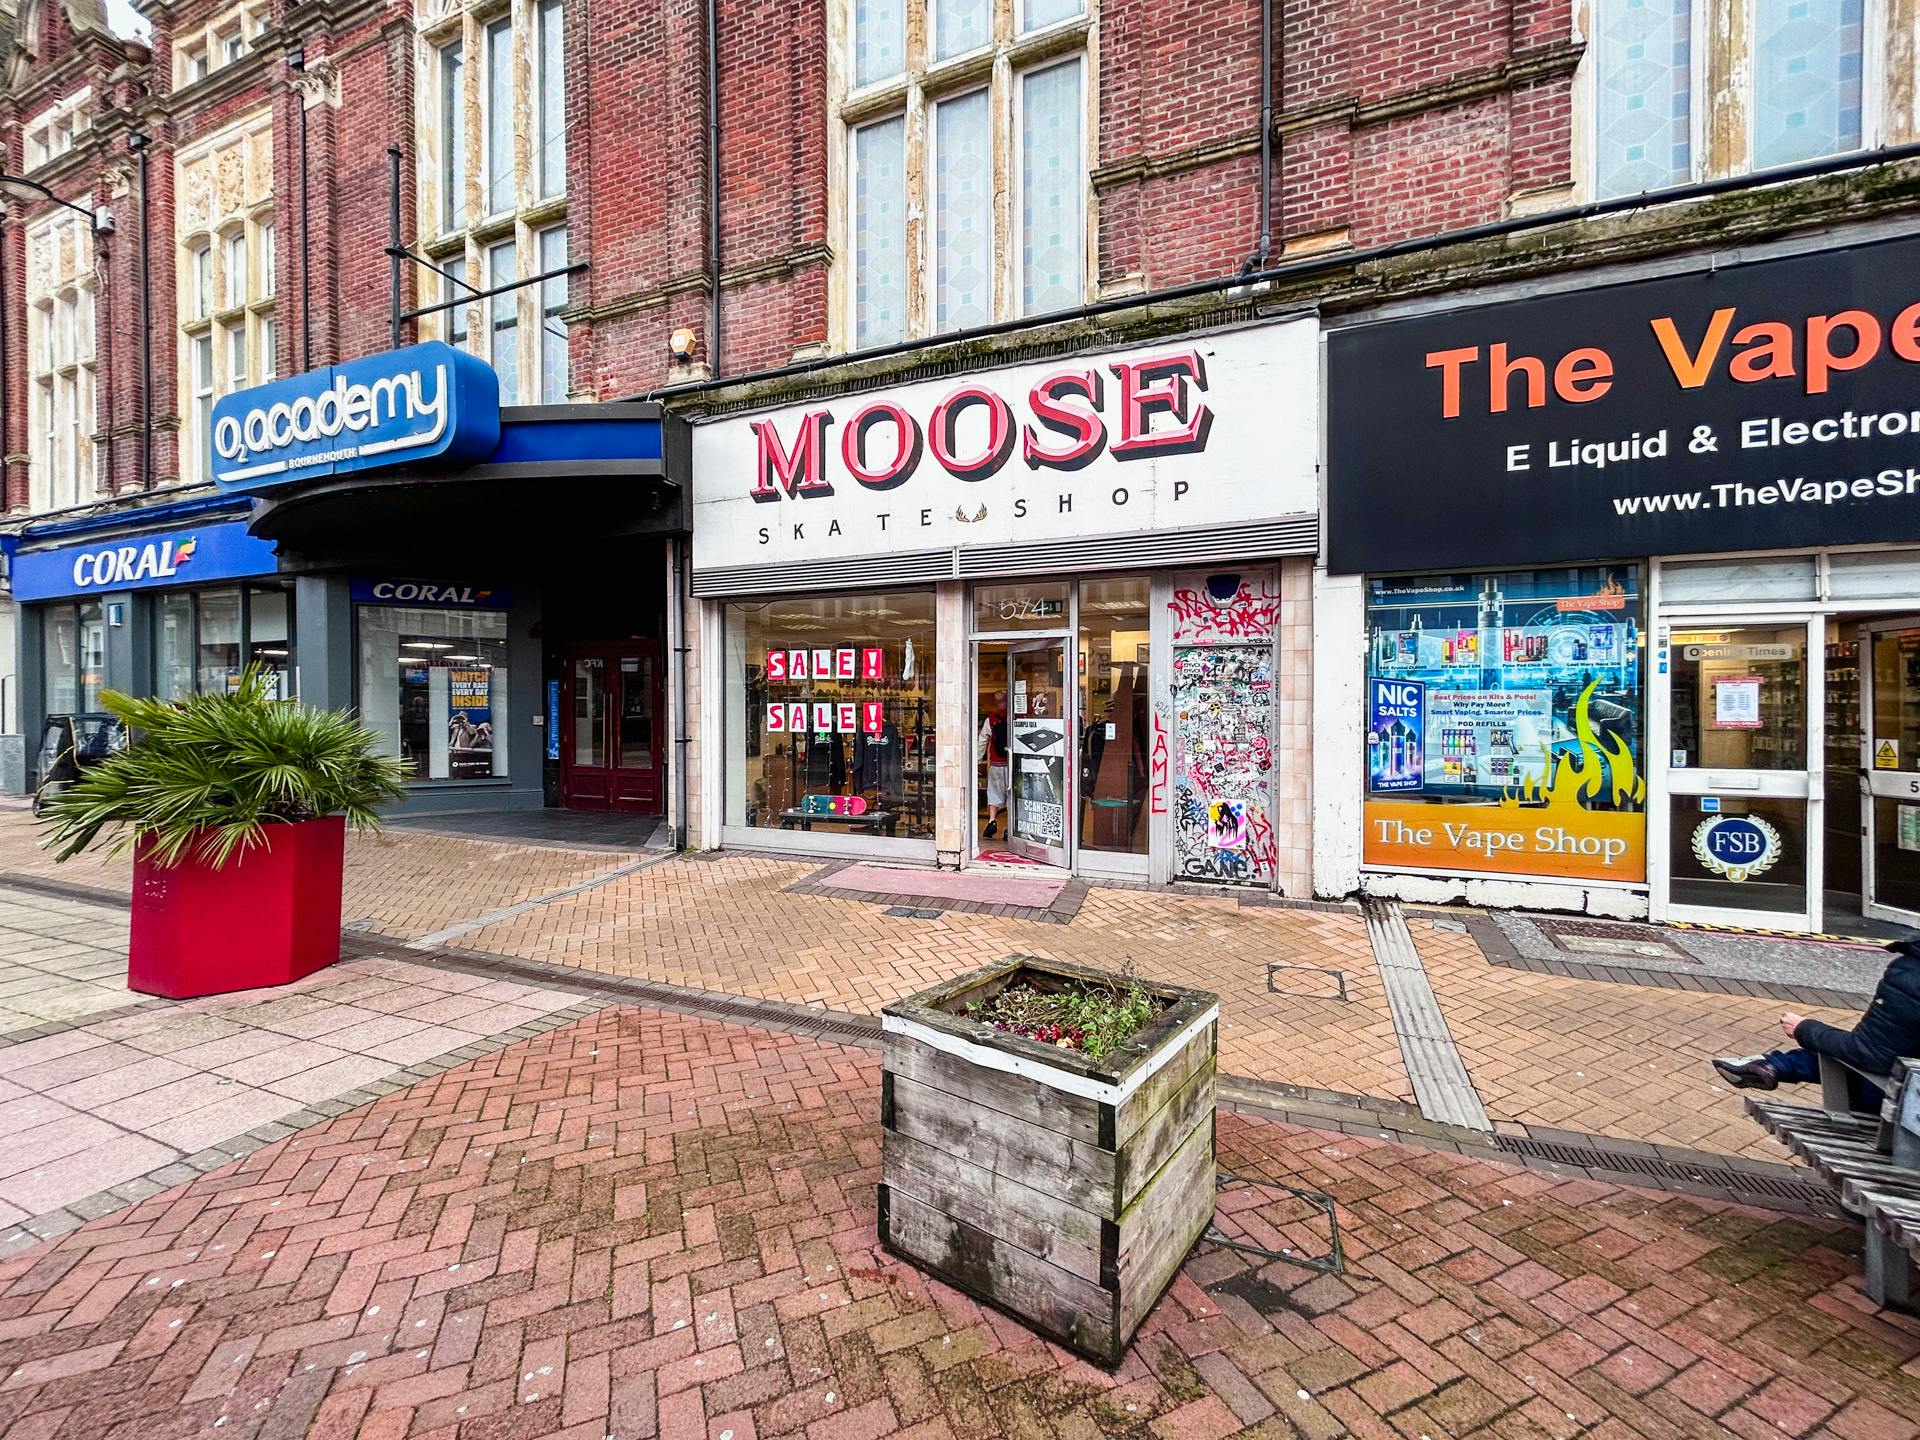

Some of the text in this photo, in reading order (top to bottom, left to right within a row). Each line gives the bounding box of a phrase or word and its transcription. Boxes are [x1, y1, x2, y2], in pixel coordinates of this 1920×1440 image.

[1425, 342, 1614, 419] The
[749, 348, 1215, 503] MOOSE
[288, 447, 358, 469] BOURNEMOUTH
[1506, 444, 1531, 472] E
[1549, 430, 1667, 469] Liquid
[1688, 425, 1718, 454] &
[757, 480, 1190, 546] SKATE SHOP
[73, 541, 177, 588] CORAL
[372, 583, 476, 604] CORAL
[1375, 585, 1465, 595] www.TheVapeShop.co.uk
[1000, 597, 1049, 620] 574
[1561, 599, 1620, 609] The Vape Shop
[1747, 646, 1786, 656] Times
[769, 651, 878, 678] SALE!
[452, 671, 488, 682] WATCH
[452, 688, 488, 696] EVERY DAY
[452, 696, 488, 707] INSIDE
[1378, 683, 1419, 707] NIC
[769, 703, 878, 730] SALE!
[1378, 705, 1418, 718] SALTS
[1024, 800, 1041, 812] SCAN
[1018, 820, 1041, 835] DONATE
[1028, 811, 1041, 824] AND
[1374, 819, 1627, 865] The Vape Shop
[1713, 831, 1761, 853] FSB
